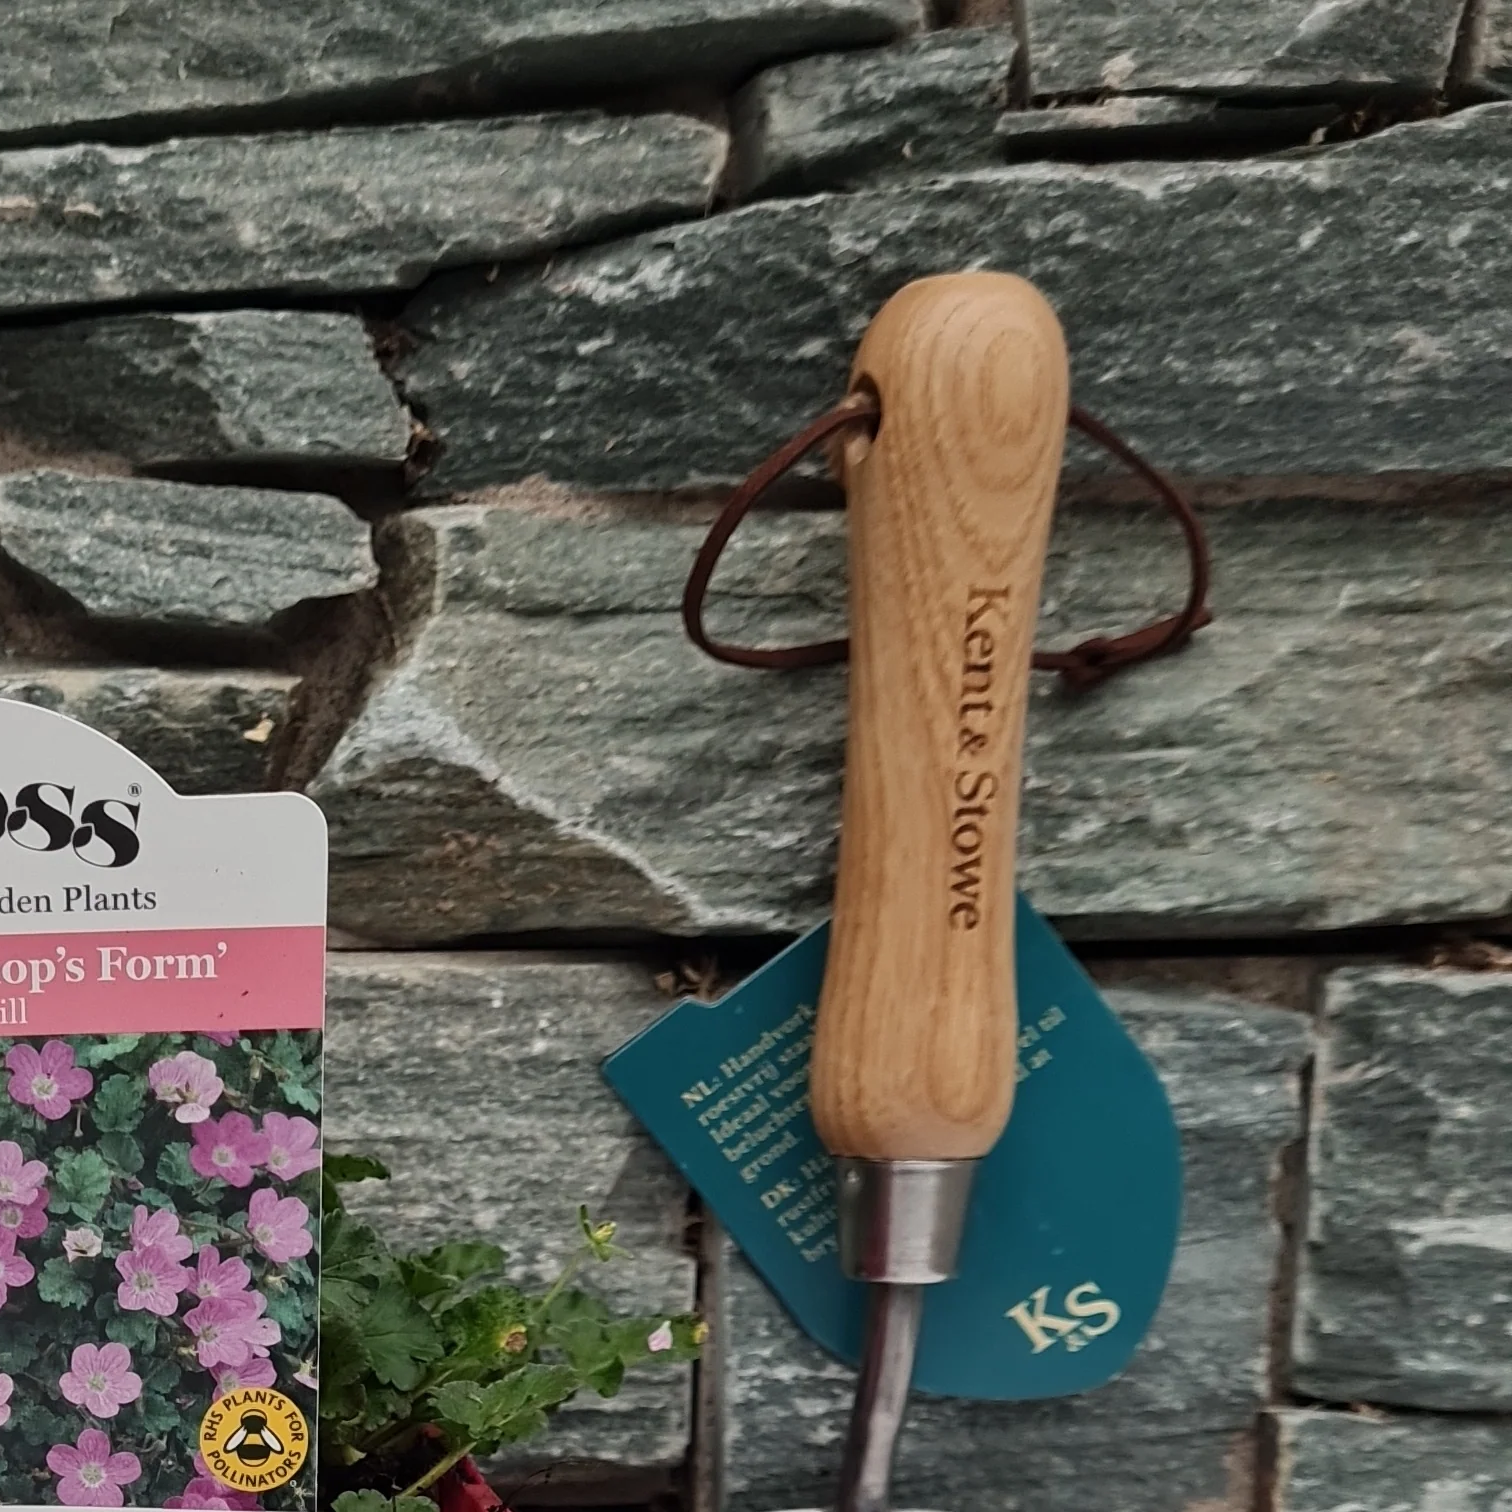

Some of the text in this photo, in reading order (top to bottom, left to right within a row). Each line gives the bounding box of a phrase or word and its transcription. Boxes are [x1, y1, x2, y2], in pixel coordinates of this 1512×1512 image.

[950, 584, 1010, 932] Kent & Stowe
[62, 884, 157, 915] Plants
[203, 1390, 305, 1443] RHS PLANTS FOR
[207, 1450, 301, 1487] POLLINATORS
